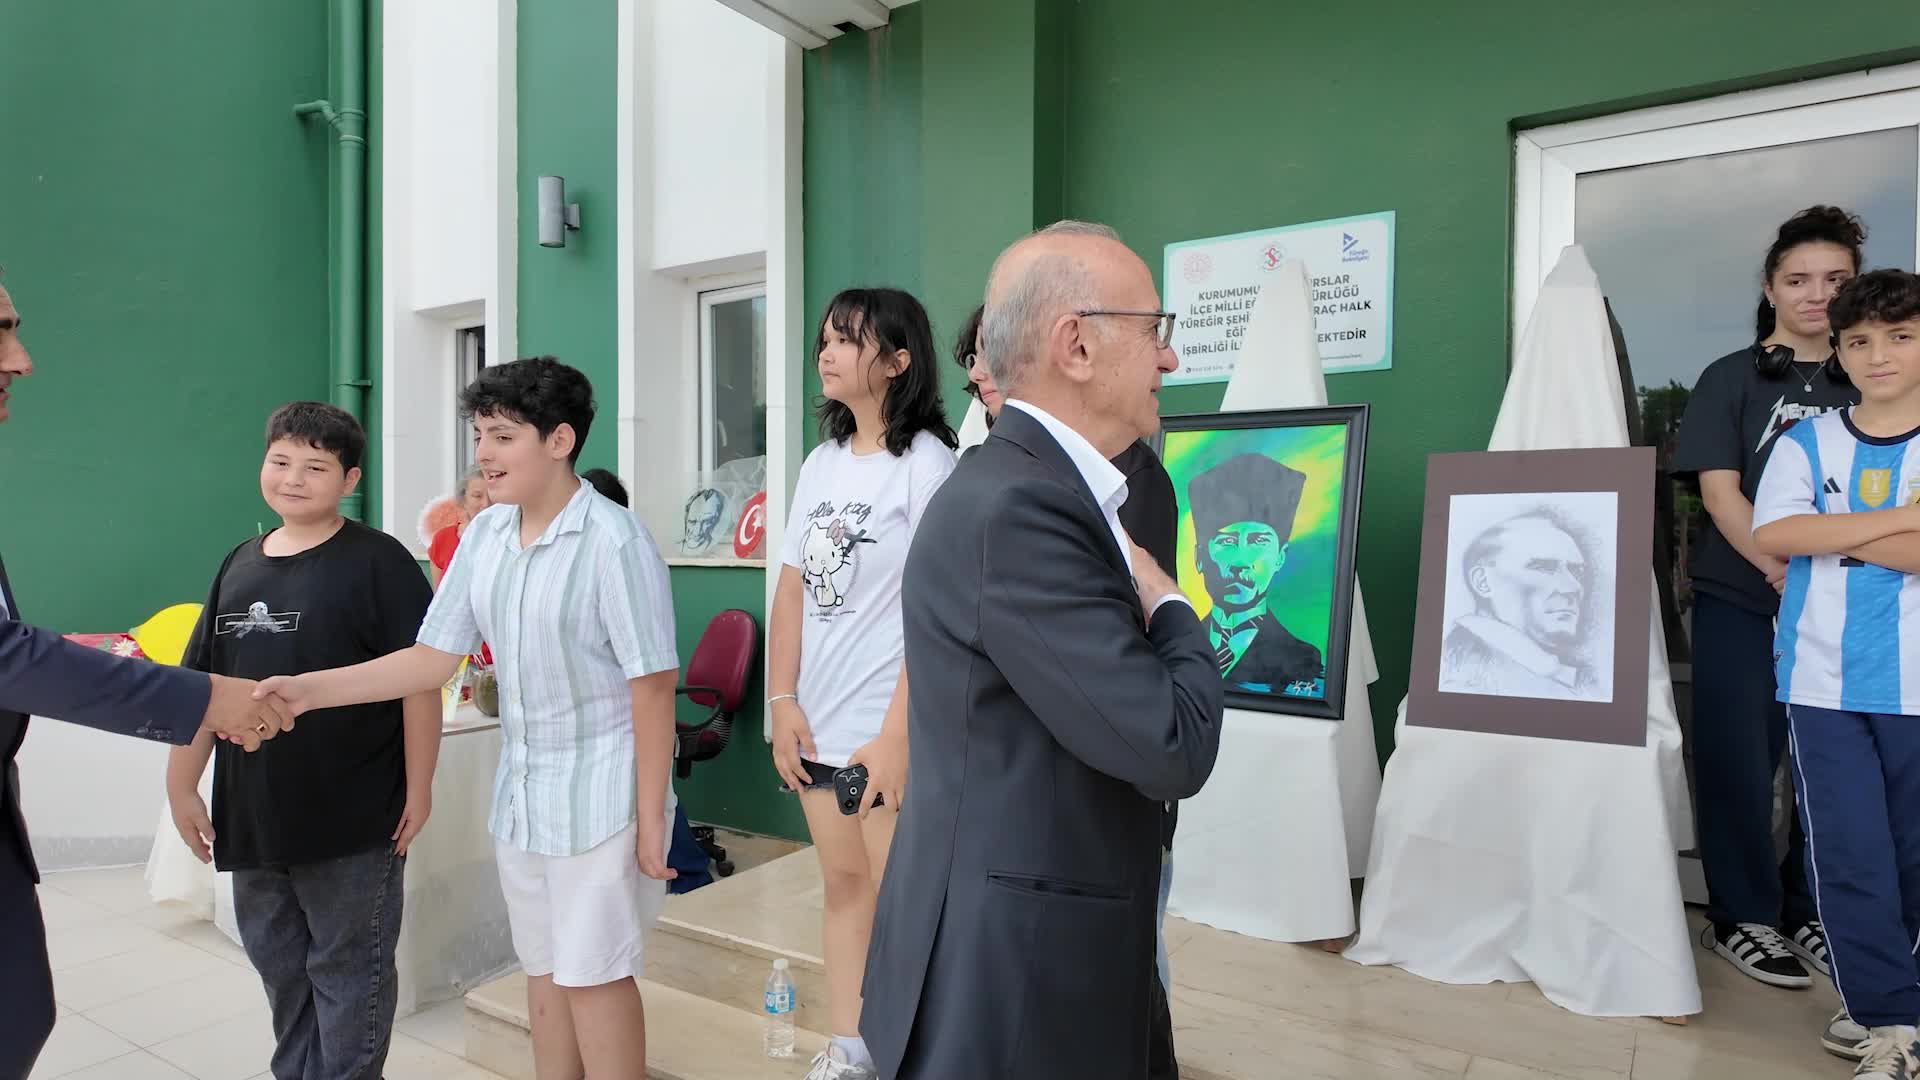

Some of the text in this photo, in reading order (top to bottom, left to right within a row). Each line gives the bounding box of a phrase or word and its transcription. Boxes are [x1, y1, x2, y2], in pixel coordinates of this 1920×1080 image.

[1310, 274, 1350, 288] RSLAR
[1190, 304, 1212, 316] İLÇE
[1215, 299, 1242, 313] MİLLİ
[1340, 300, 1372, 313] HALK
[1180, 311, 1250, 329] YÜREĞİR ŞEHİ
[1183, 340, 1242, 357] İŞBİRLİĞİ İL
